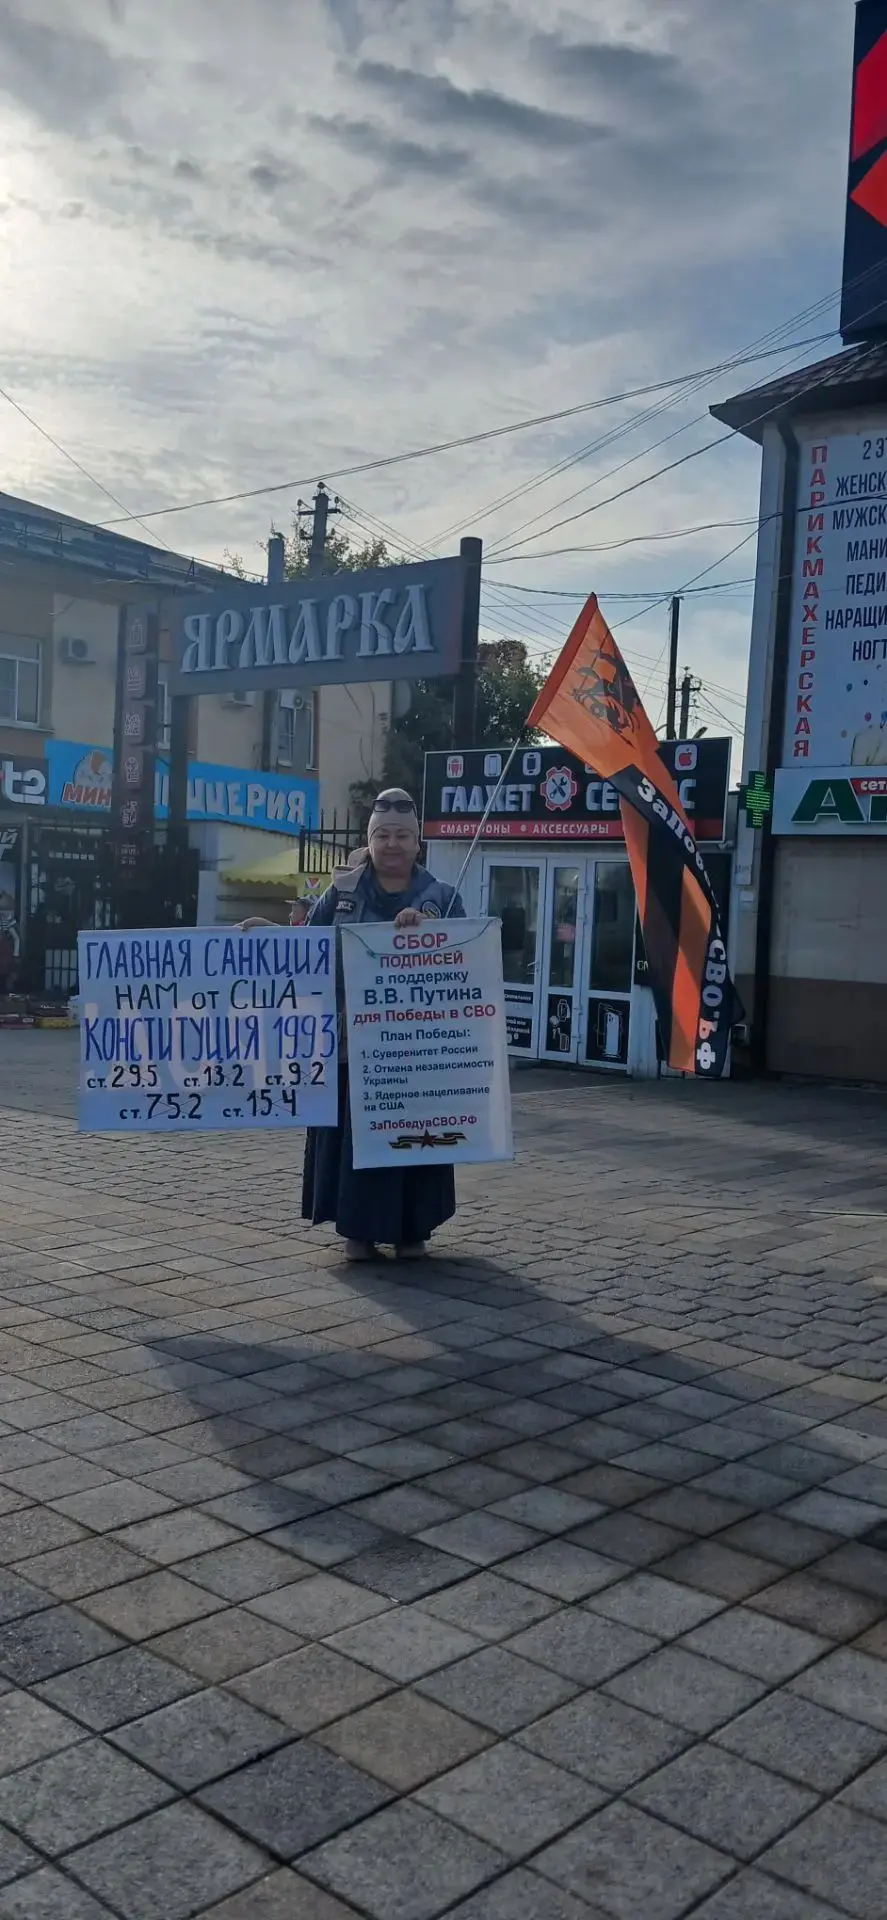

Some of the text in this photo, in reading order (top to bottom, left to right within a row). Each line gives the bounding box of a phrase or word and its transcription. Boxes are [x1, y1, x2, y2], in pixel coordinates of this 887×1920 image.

[862, 437, 887, 460] 2 Э
[793, 445, 828, 758] ПАРИКМАХЕРСКАЯ
[180, 583, 435, 673] ЯРМАРКА
[61, 781, 111, 807] МИН
[860, 780, 887, 791] сет
[440, 784, 536, 813] ГАДЖЕТ
[532, 823, 609, 835] АКСЕССУАРЫ
[393, 932, 448, 950] СБОР
[86, 938, 331, 980] ГЛАВНАЯ САНКЦИЯ
[380, 951, 463, 969] ПОДПИСЕЙ
[375, 970, 469, 985] в поддержку
[115, 982, 178, 1010] НАМ
[192, 990, 220, 1010] от
[230, 979, 297, 1010] США
[364, 986, 482, 1006] В.В. Путина
[353, 1004, 496, 1026] для Победы в СВО
[84, 1014, 336, 1063] КОНСТИТУЦИЯ 1993
[380, 1028, 471, 1043] План Победы:
[361, 1046, 478, 1061] 1. Суверенитет России
[363, 1060, 494, 1074] 2. Отмена независимости
[363, 1076, 408, 1088] Украины
[363, 1086, 490, 1101] 3. Ядерное нацеливание
[364, 1102, 405, 1112] на США
